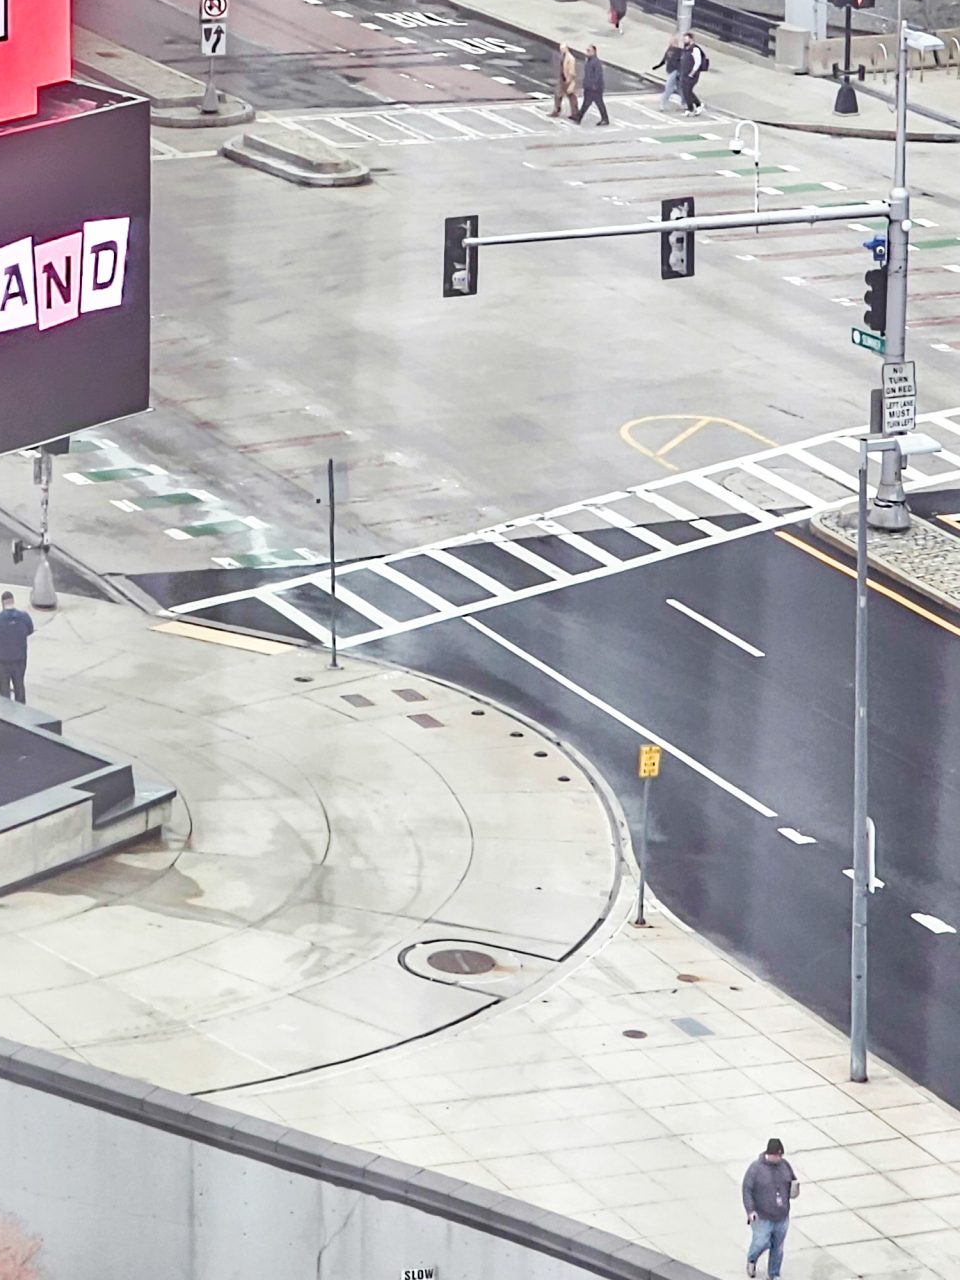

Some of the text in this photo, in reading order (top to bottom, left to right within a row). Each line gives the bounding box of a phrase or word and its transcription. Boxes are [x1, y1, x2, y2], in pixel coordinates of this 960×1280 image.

[374, 11, 468, 28] BIKE
[441, 37, 526, 55] BUS
[889, 409, 910, 418] MUST
[404, 1269, 434, 1280] SLOW
